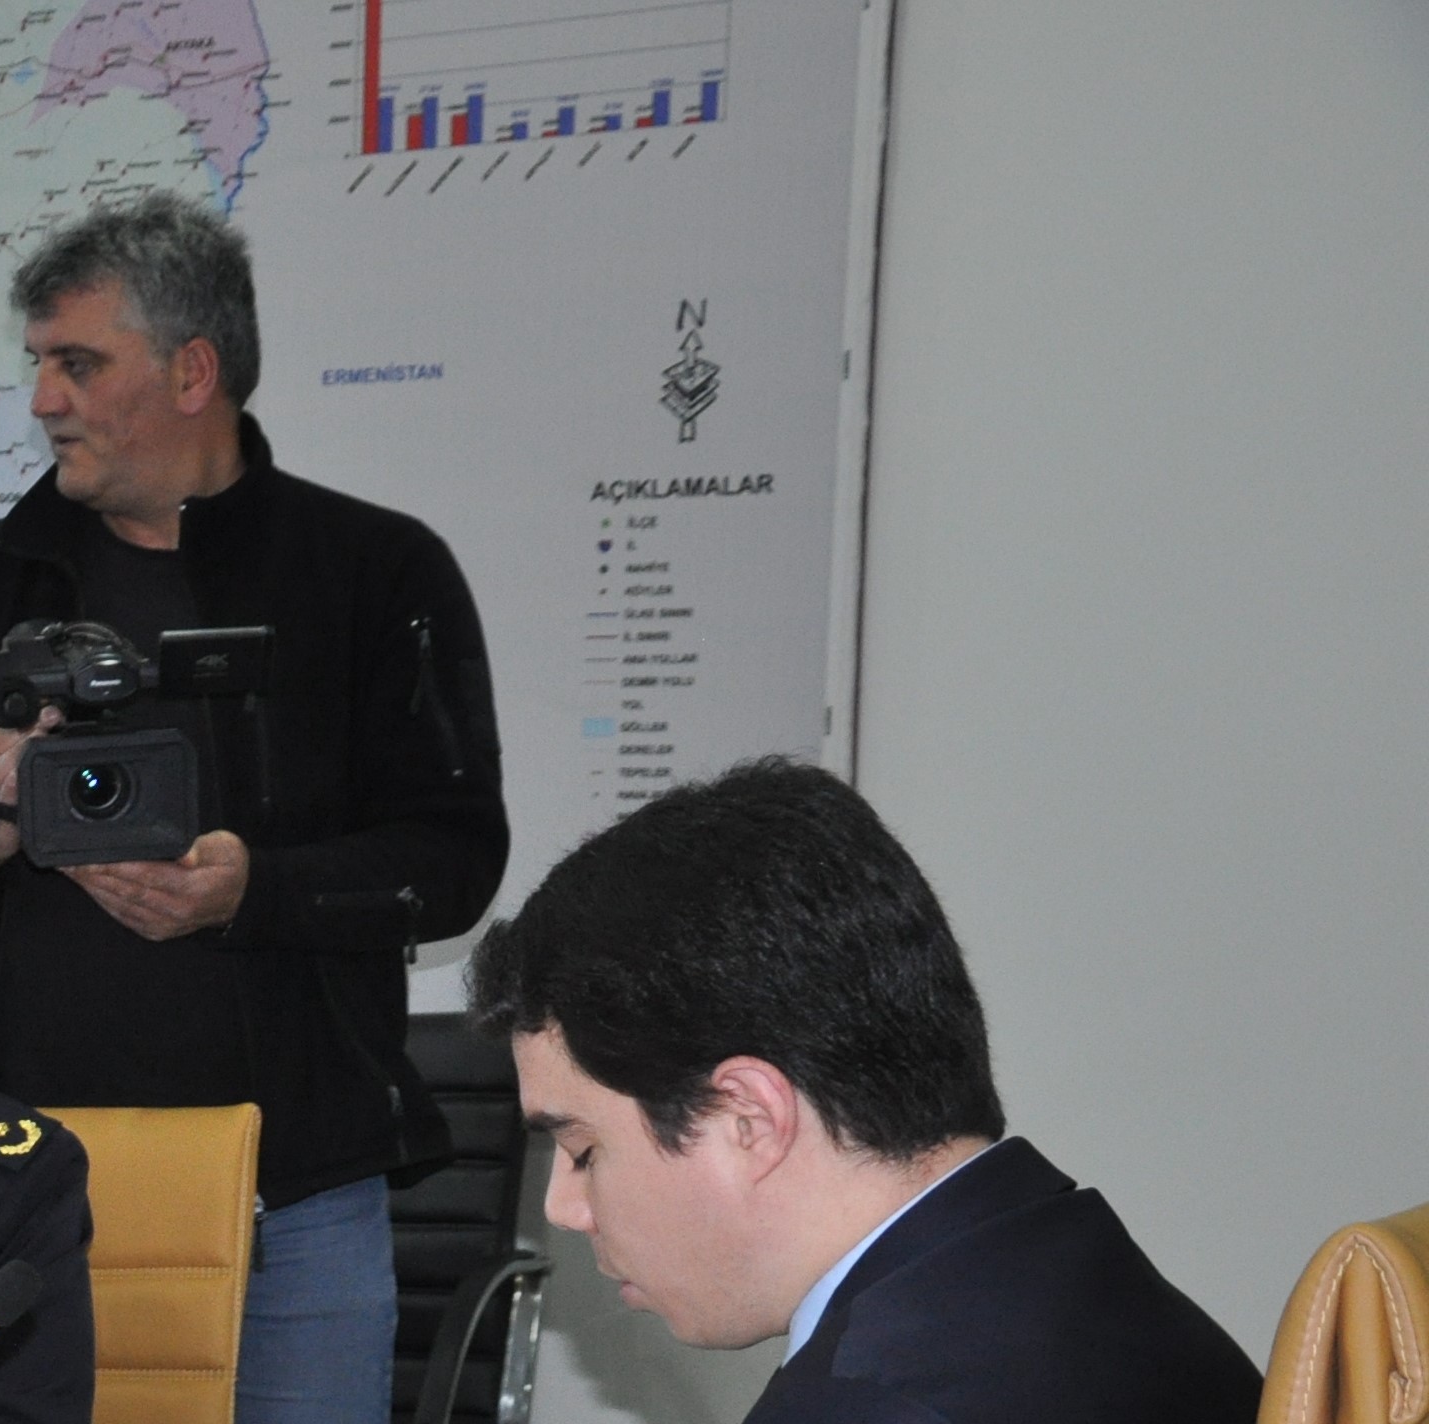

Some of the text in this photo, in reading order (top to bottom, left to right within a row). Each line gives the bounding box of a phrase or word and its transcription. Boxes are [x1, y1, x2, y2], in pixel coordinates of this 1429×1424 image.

[676, 299, 708, 331] N
[321, 362, 443, 386] ERMENİSTAN
[590, 473, 775, 505] AÇIKLAMALAR
